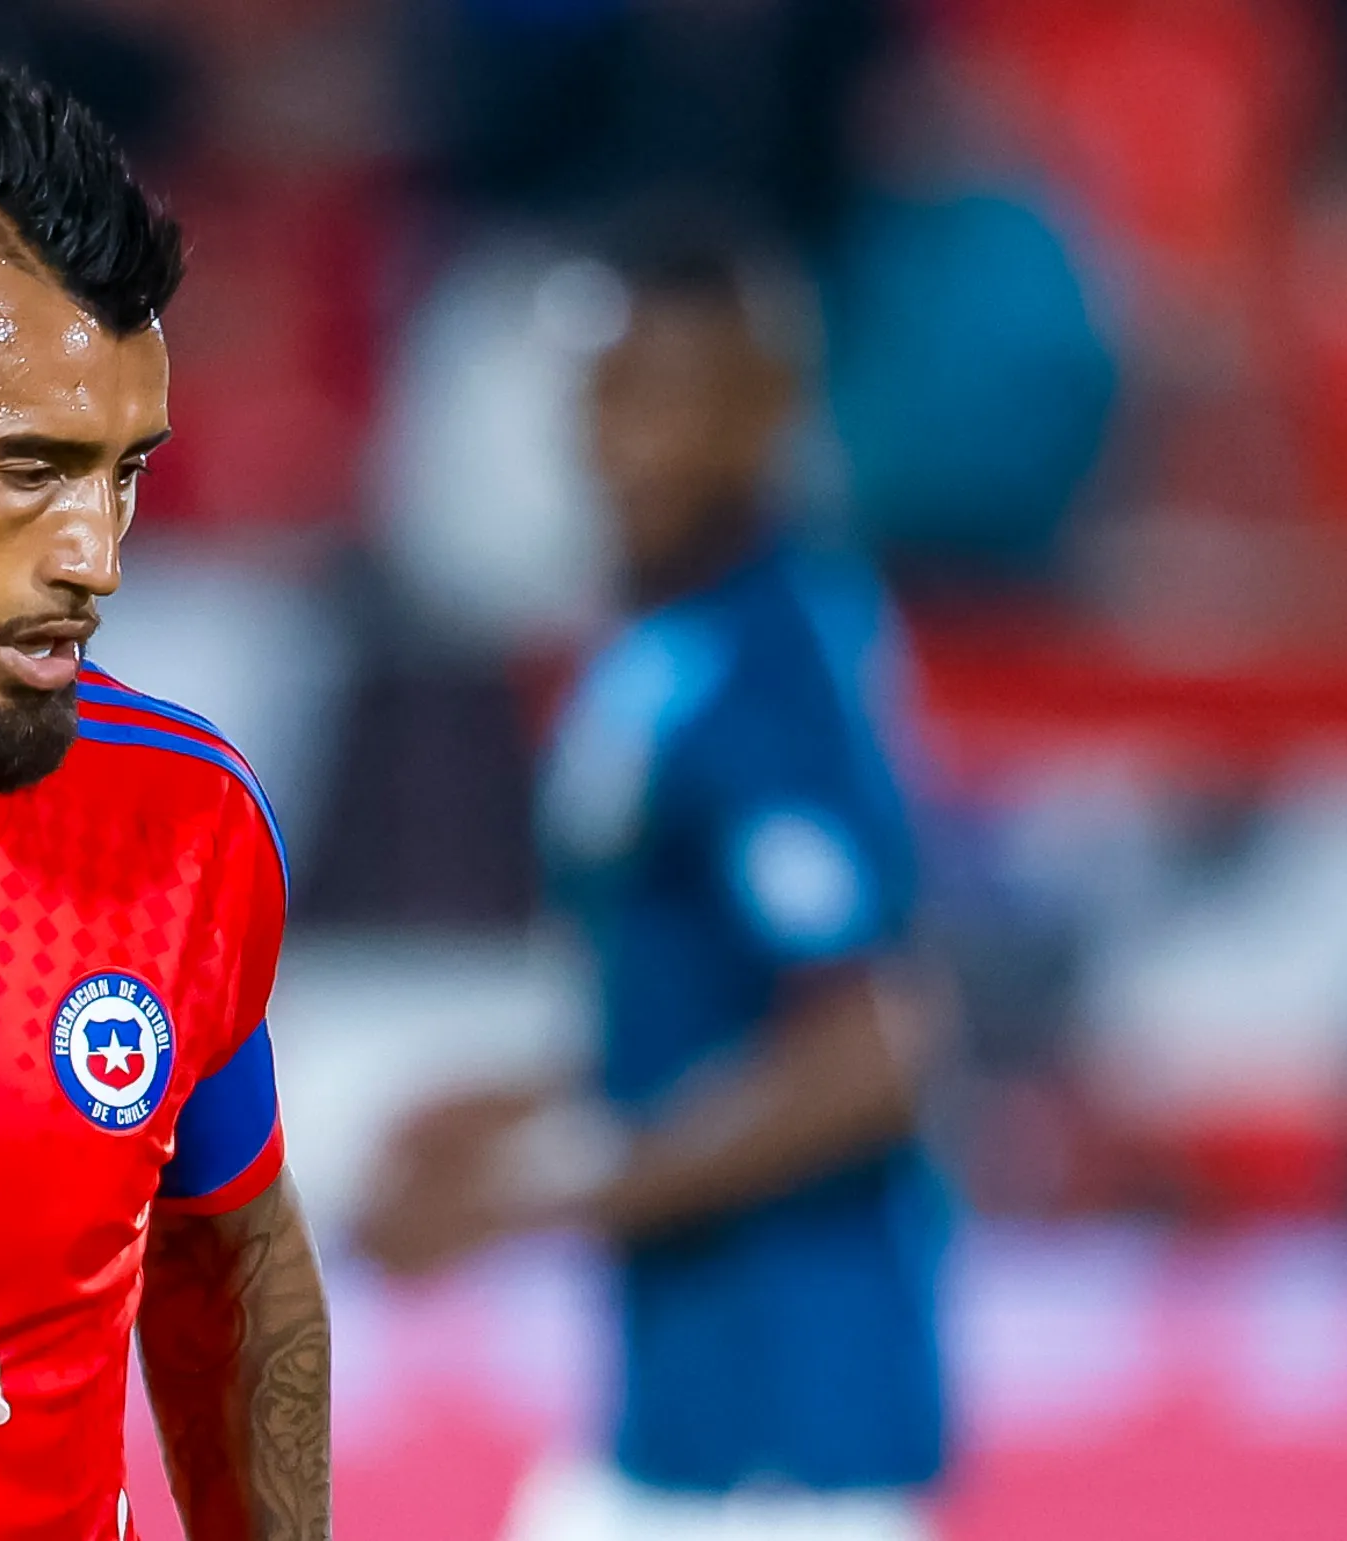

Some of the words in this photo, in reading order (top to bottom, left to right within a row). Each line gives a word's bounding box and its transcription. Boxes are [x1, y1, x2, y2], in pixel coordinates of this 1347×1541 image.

[55, 979, 109, 1056] FEDERACION
[119, 980, 137, 1000] DE
[140, 995, 170, 1054] FUTBOL
[91, 1105, 109, 1122] DE
[116, 1100, 149, 1125] CHILE
